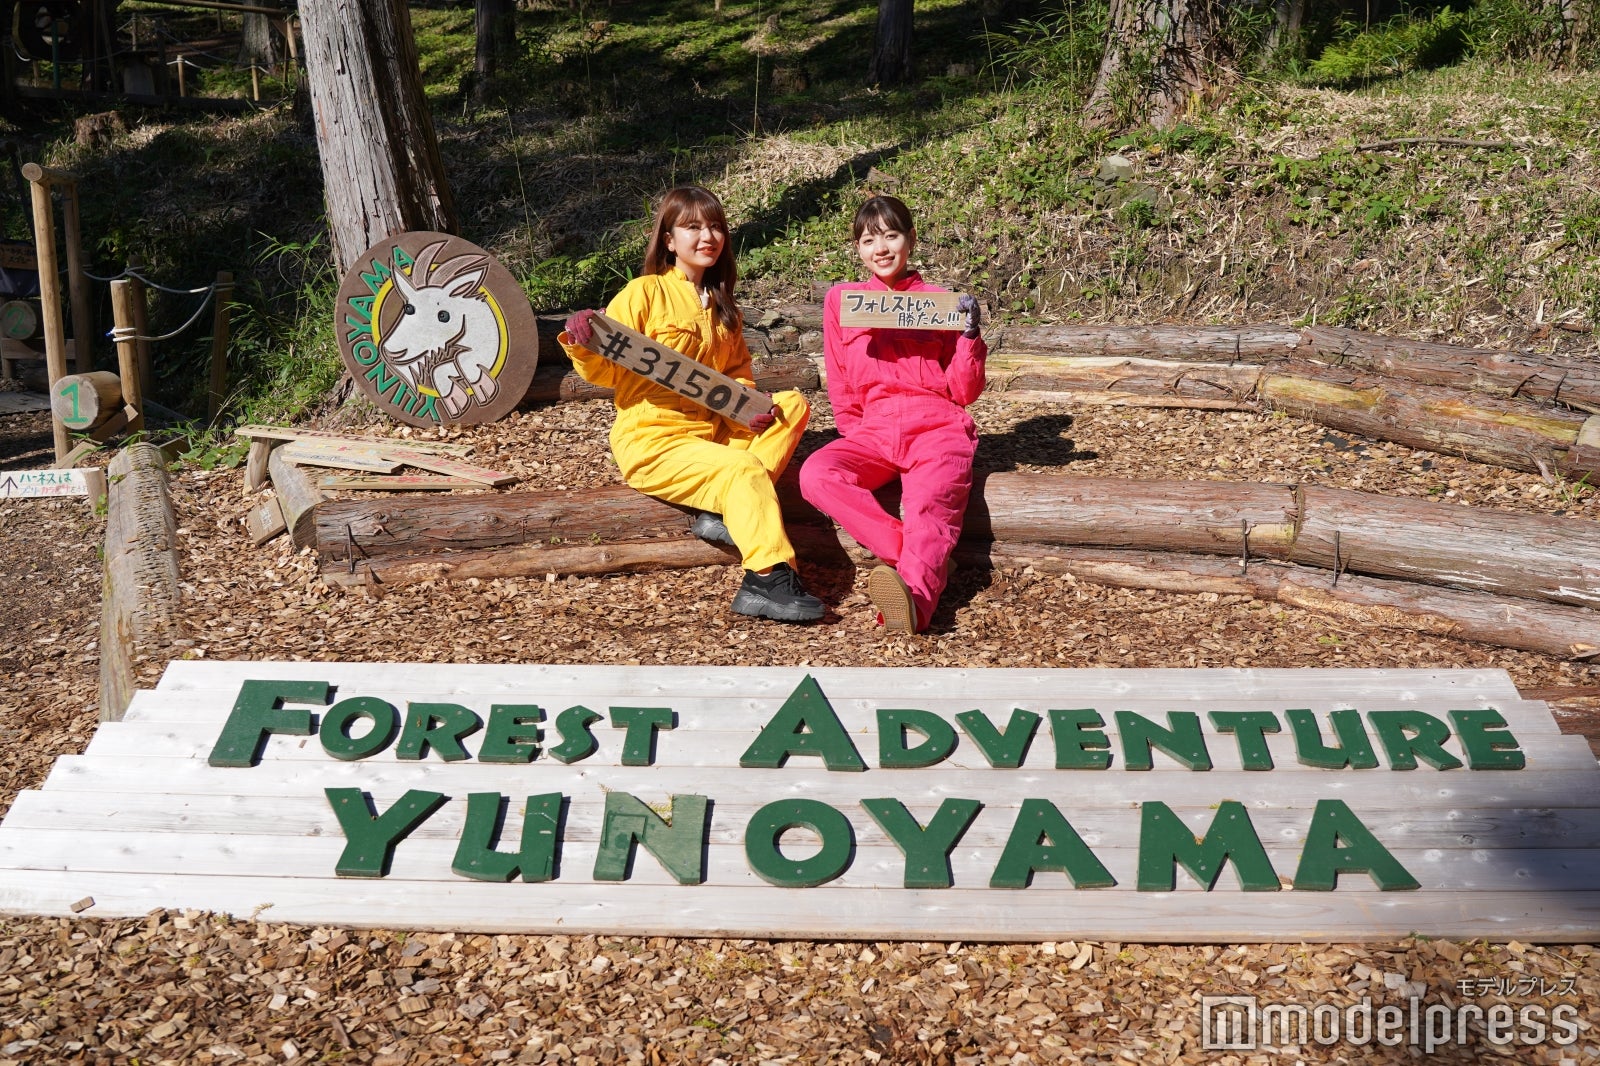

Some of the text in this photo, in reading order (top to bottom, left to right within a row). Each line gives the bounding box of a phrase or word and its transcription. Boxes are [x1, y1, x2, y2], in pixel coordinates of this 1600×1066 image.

[7, 306, 29, 334] 2
[346, 246, 441, 422] YUNOYAMA
[846, 294, 936, 313] フォレストしか
[60, 382, 88, 423] 1
[600, 331, 750, 418] #3150!
[324, 787, 1422, 893] YUNOYAMA
